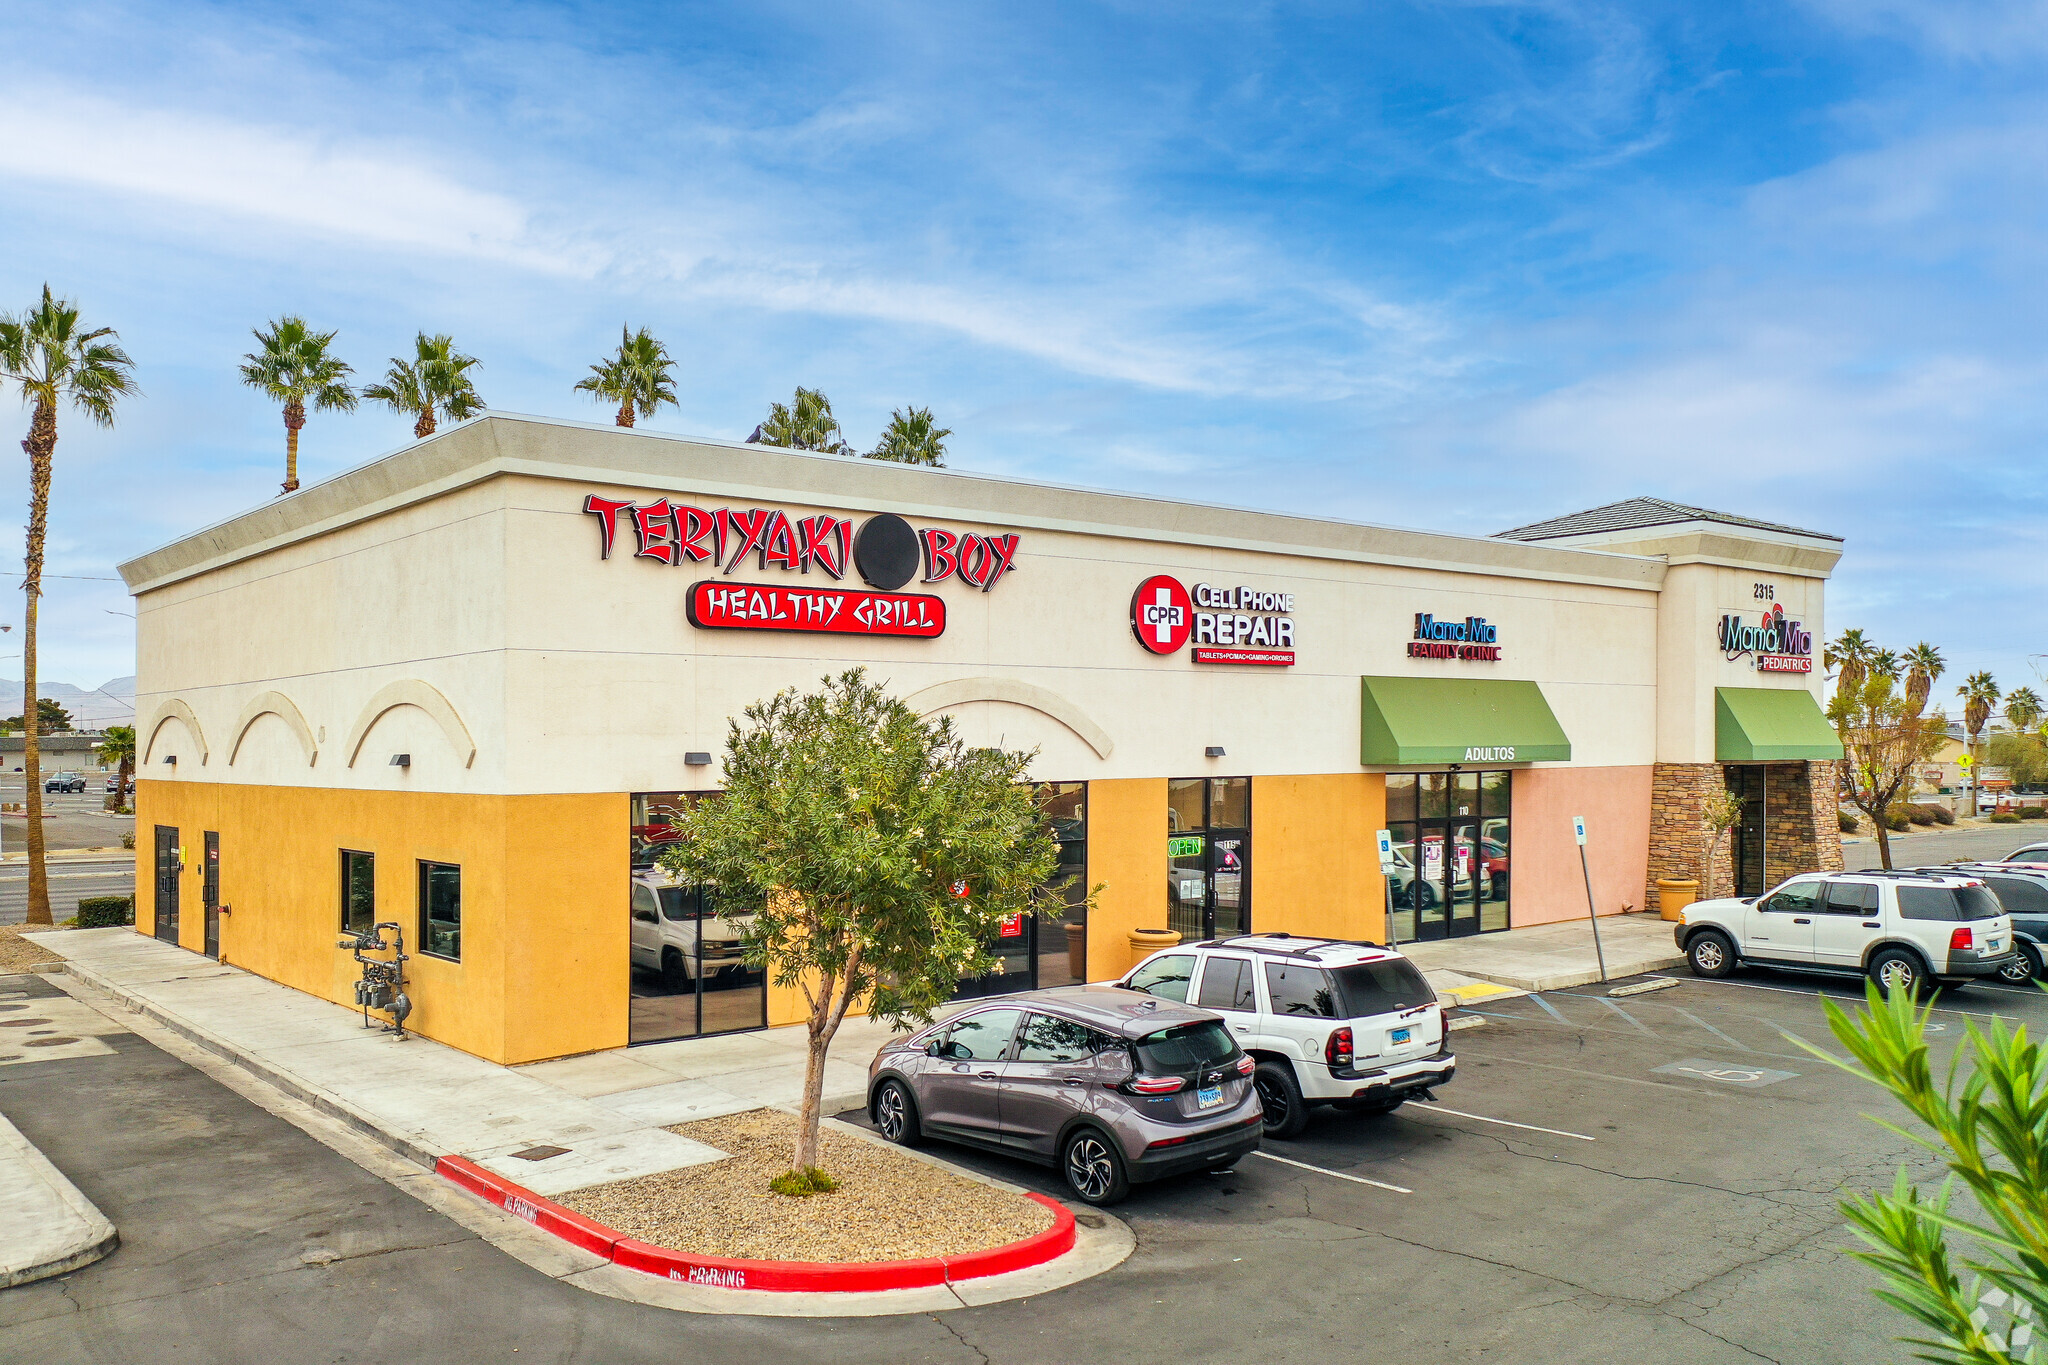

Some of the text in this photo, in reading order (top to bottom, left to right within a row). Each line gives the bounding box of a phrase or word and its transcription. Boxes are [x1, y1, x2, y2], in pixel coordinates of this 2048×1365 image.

[583, 494, 1021, 593] TERIYAKI BOY
[1753, 583, 1774, 600] 2315
[707, 588, 936, 631] HEALTHY GRILL
[1147, 606, 1180, 625] CPR
[1195, 613, 1295, 647] REPAIR
[1418, 613, 1497, 643] Mama Mia
[1724, 615, 1812, 655] Mama Mia
[1411, 642, 1502, 661] FAMILY CLINIC
[1763, 656, 1811, 671] PEDIATRICS
[1464, 746, 1515, 761] ADULTOS
[1458, 805, 1469, 816] 110
[1169, 838, 1201, 856] OPEN
[512, 1197, 539, 1222] PARKING
[688, 1265, 746, 1288] PARKING
